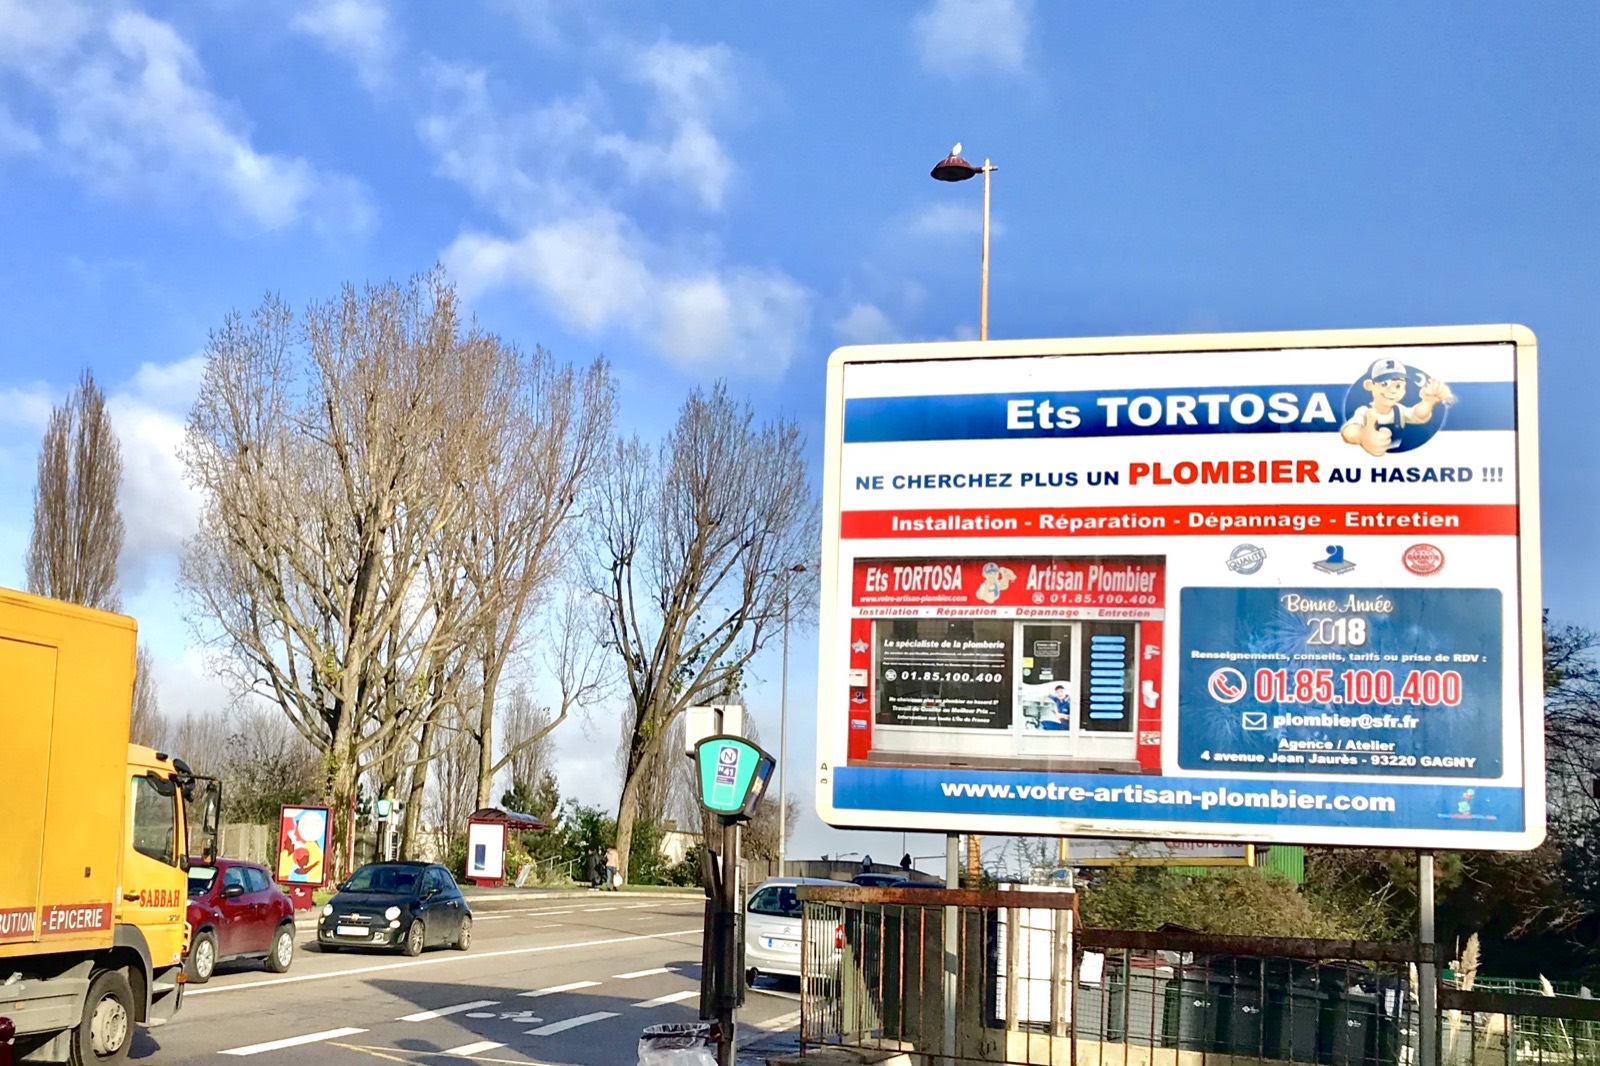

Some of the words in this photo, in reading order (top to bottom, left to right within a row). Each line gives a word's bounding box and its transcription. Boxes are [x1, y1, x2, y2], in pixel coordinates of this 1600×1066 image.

[1006, 399, 1081, 430] Ets
[1097, 392, 1337, 427] TORTOSA
[855, 476, 884, 490] NE
[892, 473, 1013, 489] CHERCHEZ
[1021, 472, 1078, 487] PLUS
[1087, 471, 1119, 486] UN
[1128, 460, 1320, 485] PLOMBIER
[1328, 468, 1361, 483] AU
[1371, 467, 1473, 483] HASARD
[1482, 467, 1504, 482] !!!
[891, 515, 1017, 531] Installation
[1039, 513, 1166, 532] Réparation
[1188, 511, 1322, 531] Dépannage
[1344, 511, 1459, 528] Entretien
[865, 567, 889, 592] Ets
[893, 565, 963, 591] TORTOSA
[1026, 564, 1084, 591] Artisan
[1087, 565, 1157, 593] Plombier
[1049, 593, 1157, 604] 01.85.100.400
[1281, 593, 1338, 612] Bonne
[1338, 594, 1394, 612] Année
[859, 608, 919, 616] Installation
[936, 607, 997, 617] Réparation
[1015, 607, 1080, 618] Dépannage
[1098, 608, 1151, 618] Entretien
[1306, 617, 1367, 646] 2018
[883, 638, 895, 648] Le
[895, 639, 939, 650] spécialiste
[940, 639, 951, 648] de
[952, 640, 961, 648] la
[962, 640, 1005, 650] plomberie
[1190, 650, 1291, 662] Renseignements,
[1293, 652, 1346, 662] conseils,
[1349, 653, 1380, 662] tarifs
[1383, 654, 1398, 662] ou
[1401, 653, 1432, 663] prise
[1435, 654, 1450, 662] de
[1453, 654, 1479, 663] RDV
[901, 670, 1003, 683] 01.85.100.400
[1254, 667, 1462, 706] 01.85.100.400
[1272, 713, 1420, 730] plombier@sfr.fr
[1278, 738, 1333, 750] Agence
[1345, 740, 1395, 751] Atelier
[723, 751, 733, 761] N
[1200, 750, 1211, 761] 4
[1213, 752, 1266, 762] avenue
[1268, 752, 1305, 763] Jean
[1308, 753, 1358, 764] Jaurès
[1370, 755, 1417, 766] 93220
[1420, 756, 1477, 768] GAGNY
[941, 781, 1396, 813] www.votre-artisan-plombier.com
[140, 889, 181, 908] SABBAH
[49, 905, 104, 931] ÉPICERIE
